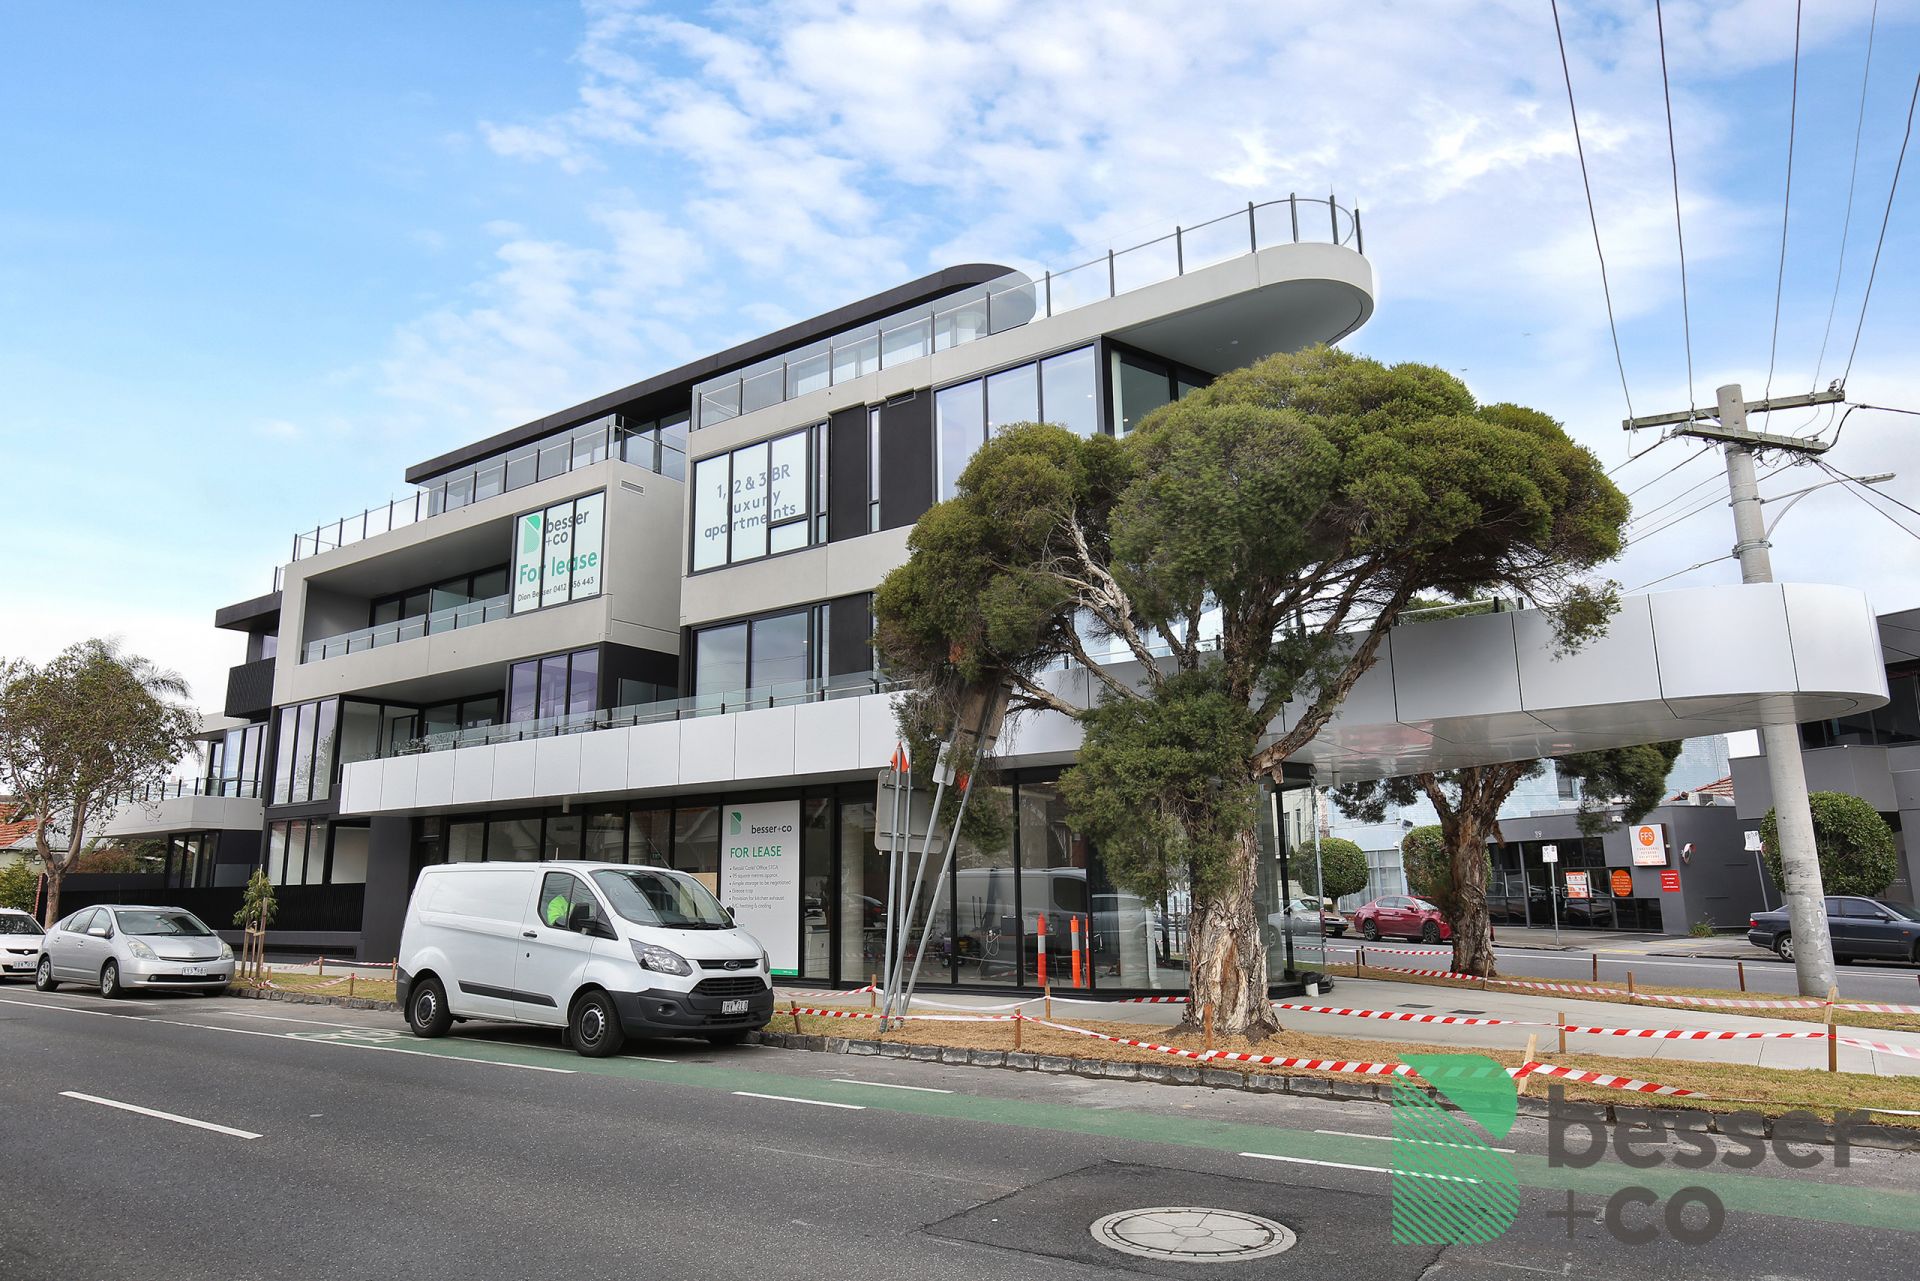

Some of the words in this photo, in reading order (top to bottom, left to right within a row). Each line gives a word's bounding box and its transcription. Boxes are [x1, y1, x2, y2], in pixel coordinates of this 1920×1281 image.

[717, 484, 726, 500] 1,
[734, 480, 742, 494] 2
[745, 476, 755, 490] &
[759, 472, 766, 486] 3
[772, 464, 790, 482] BR
[727, 490, 781, 516] uxury
[546, 511, 589, 534] besser
[704, 504, 796, 541] apartments
[520, 564, 546, 584] For
[552, 552, 598, 576] lease
[553, 584, 567, 592] 0412
[582, 576, 594, 586] 443
[751, 824, 792, 835] besser+co
[1640, 832, 1653, 842] FFS
[730, 848, 748, 858] FOR
[753, 846, 782, 858] LEASE
